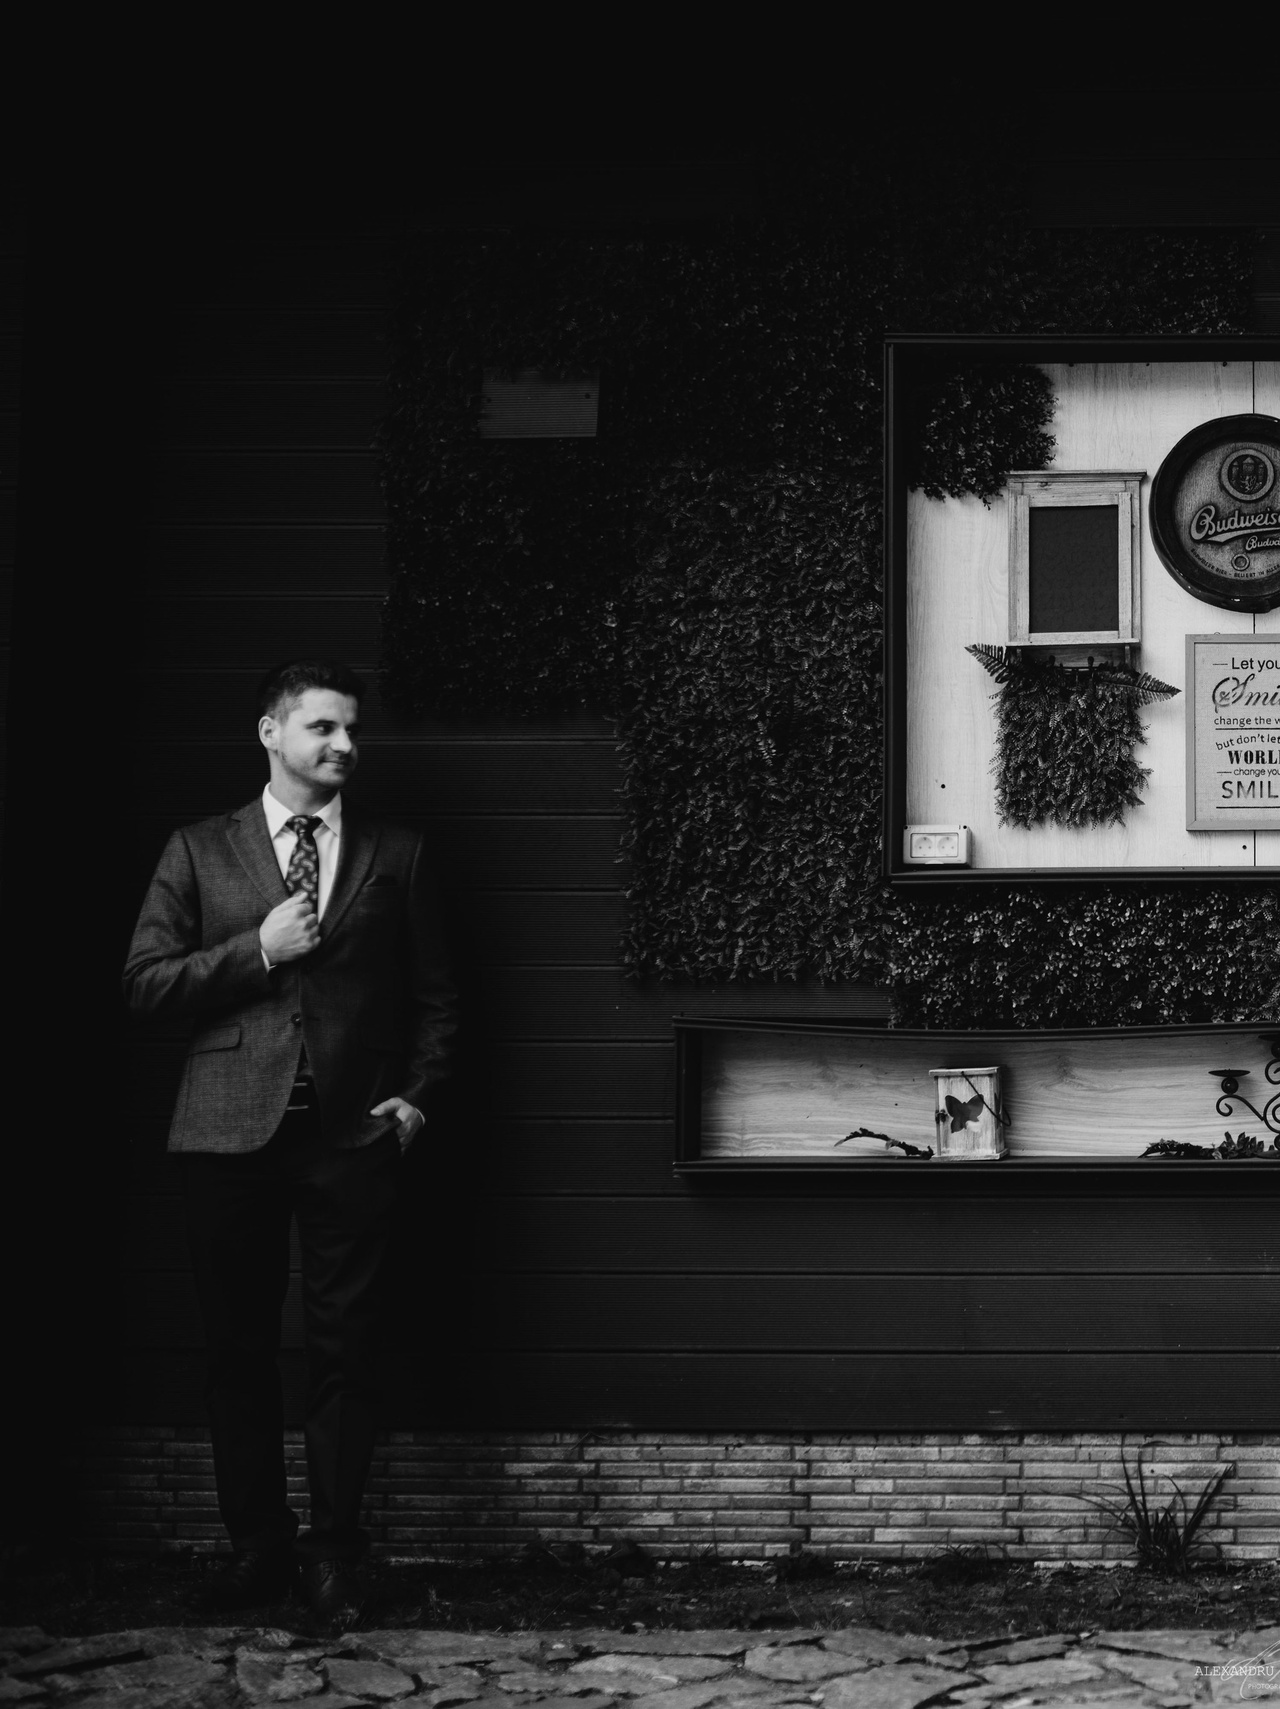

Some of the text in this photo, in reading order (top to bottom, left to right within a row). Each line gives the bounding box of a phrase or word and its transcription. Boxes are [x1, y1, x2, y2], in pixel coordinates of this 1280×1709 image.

[1231, 657, 1254, 670] Let
[1213, 716, 1252, 728] change
[1254, 716, 1272, 725] the
[1215, 738, 1235, 751] but
[1236, 733, 1265, 745] don't
[1233, 767, 1266, 778] change
